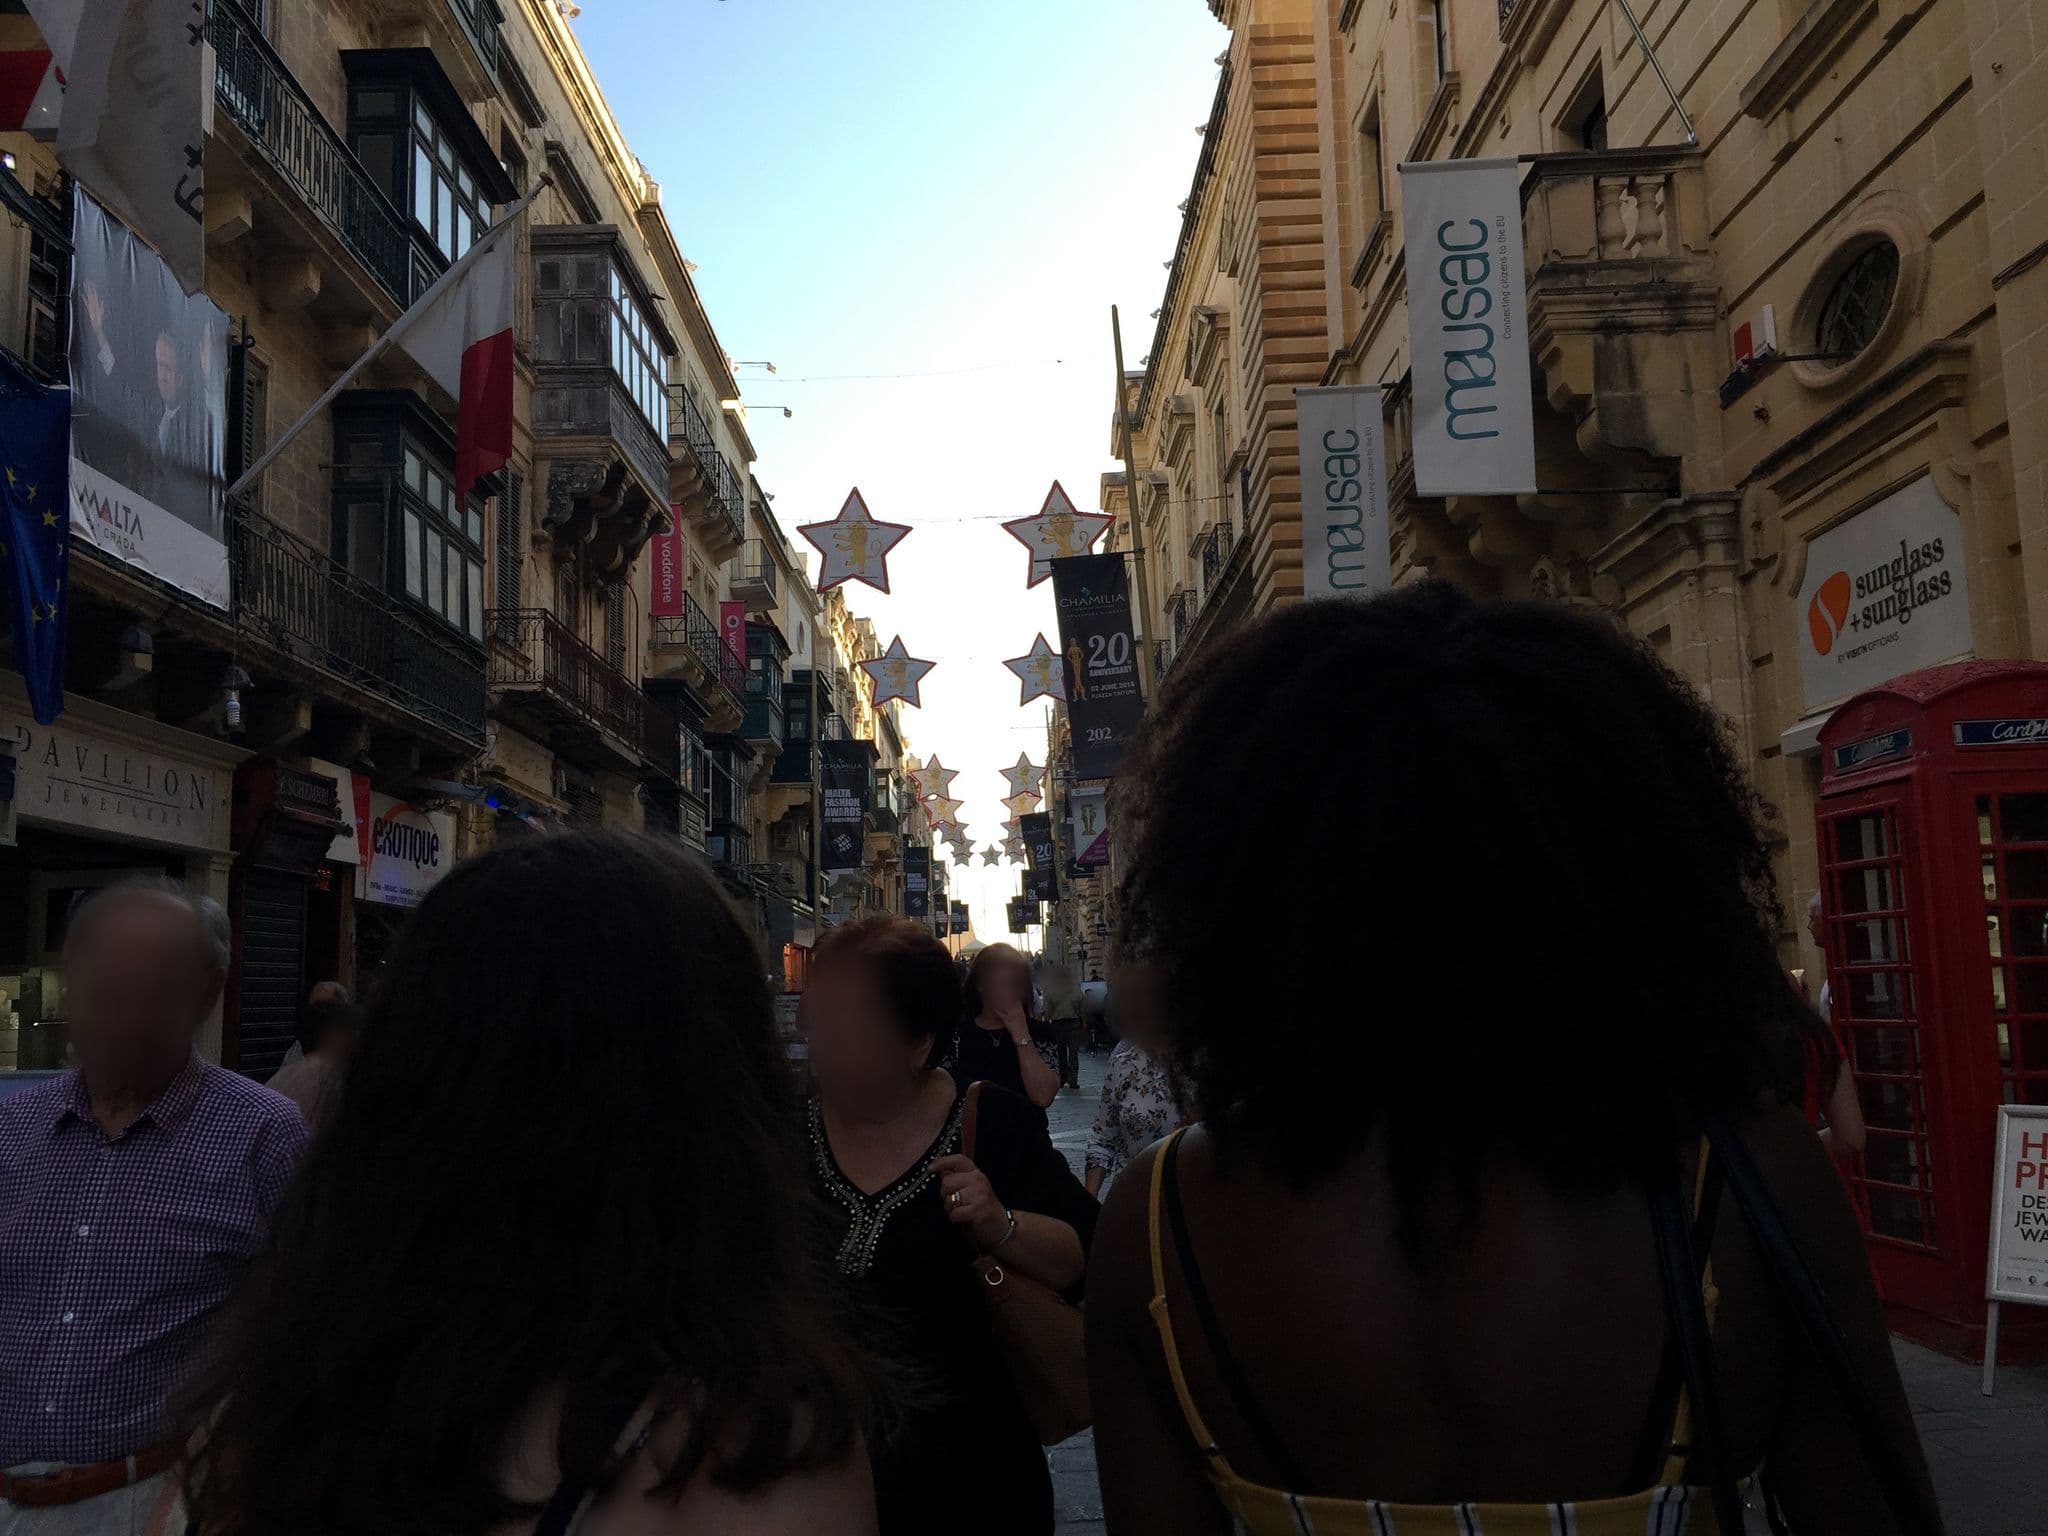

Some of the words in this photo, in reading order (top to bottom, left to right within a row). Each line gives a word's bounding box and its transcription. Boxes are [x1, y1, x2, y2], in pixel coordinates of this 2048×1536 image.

[1496, 215, 1505, 228] EU
[1497, 229, 1506, 243] the
[1498, 245, 1507, 256] to
[1500, 256, 1510, 290] citizens
[1501, 291, 1512, 340] Connecting
[79, 484, 144, 541] MALTA
[661, 541, 673, 603] vodafone
[1856, 538, 1945, 599] sunglass
[1060, 593, 1127, 608] CHAMILIA
[1086, 727, 1112, 742] 202
[824, 788, 851, 798] MALTA
[45, 785, 183, 827] JEWELLERS
[824, 798, 860, 807] FASHION
[824, 807, 862, 817] AWARDS
[1036, 843, 1052, 858] 20
